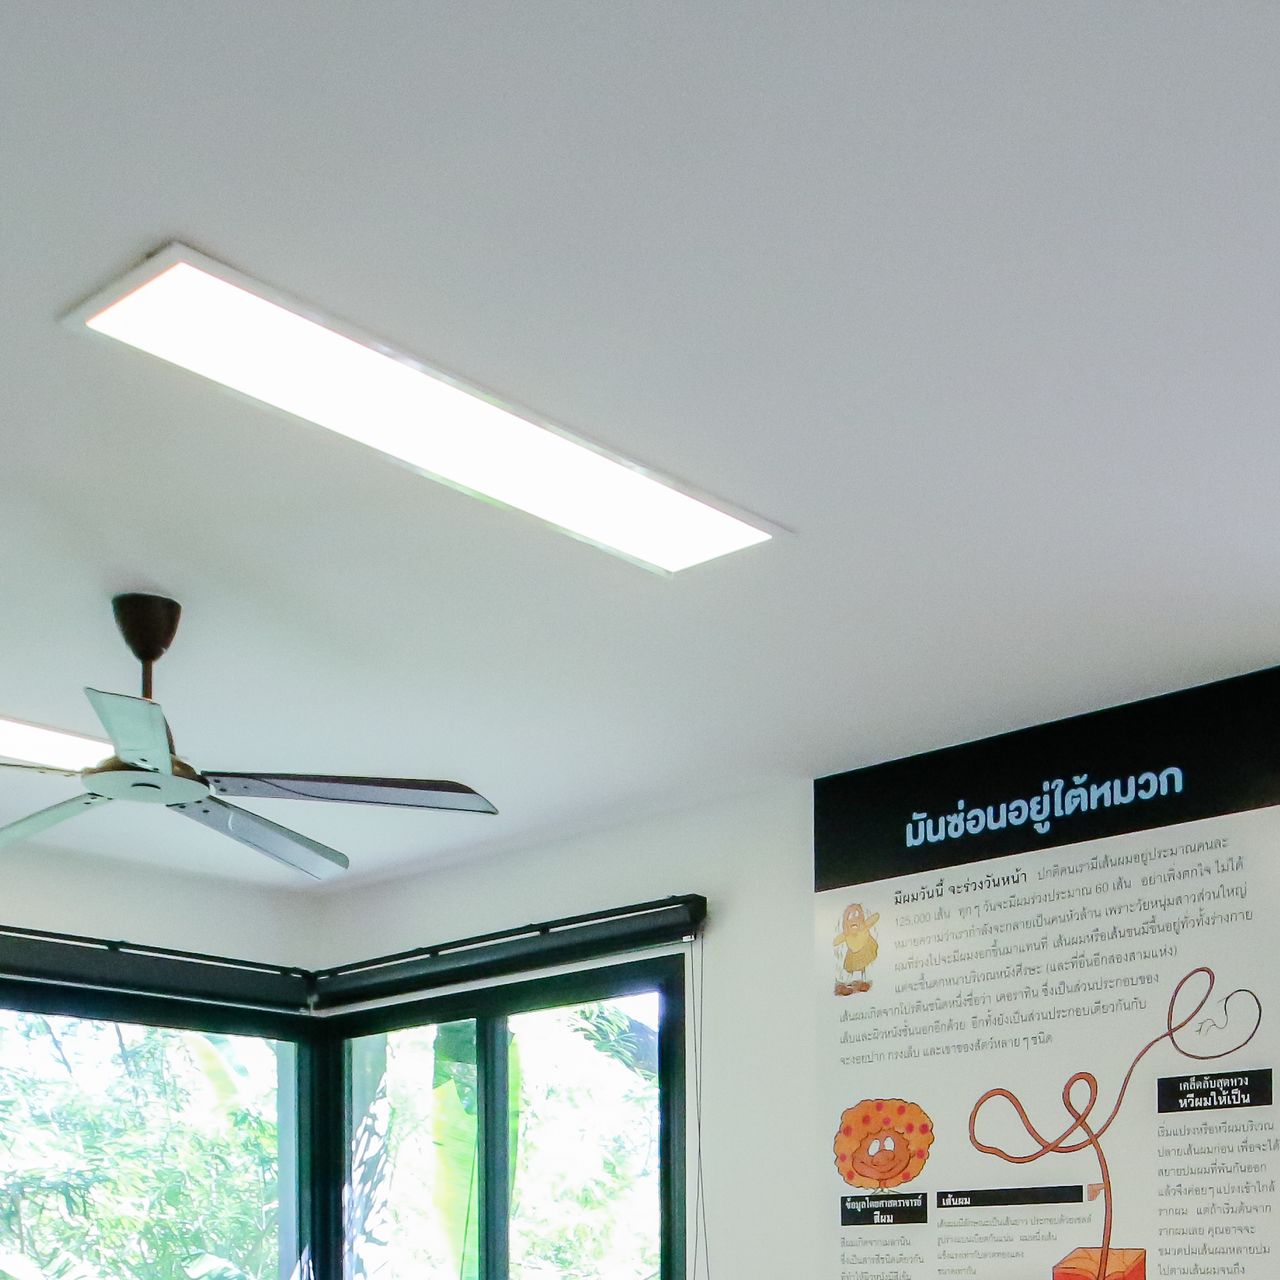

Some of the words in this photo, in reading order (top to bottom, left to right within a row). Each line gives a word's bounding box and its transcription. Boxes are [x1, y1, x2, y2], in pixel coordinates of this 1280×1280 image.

[906, 767, 1183, 847] มันซ่อนอยู่ใต้หมวก
[894, 878, 944, 905] มีผมวันนี้
[948, 868, 1027, 896] จะร่วงวันหน้า
[1096, 882, 1109, 893] 60
[1113, 877, 1132, 891] เส้น
[1215, 855, 1244, 873] ไม่ได้
[1178, 1088, 1250, 1108] หวีผมให้เป็น
[942, 1194, 971, 1206] เส้นผม
[873, 1211, 894, 1223] สีผม
